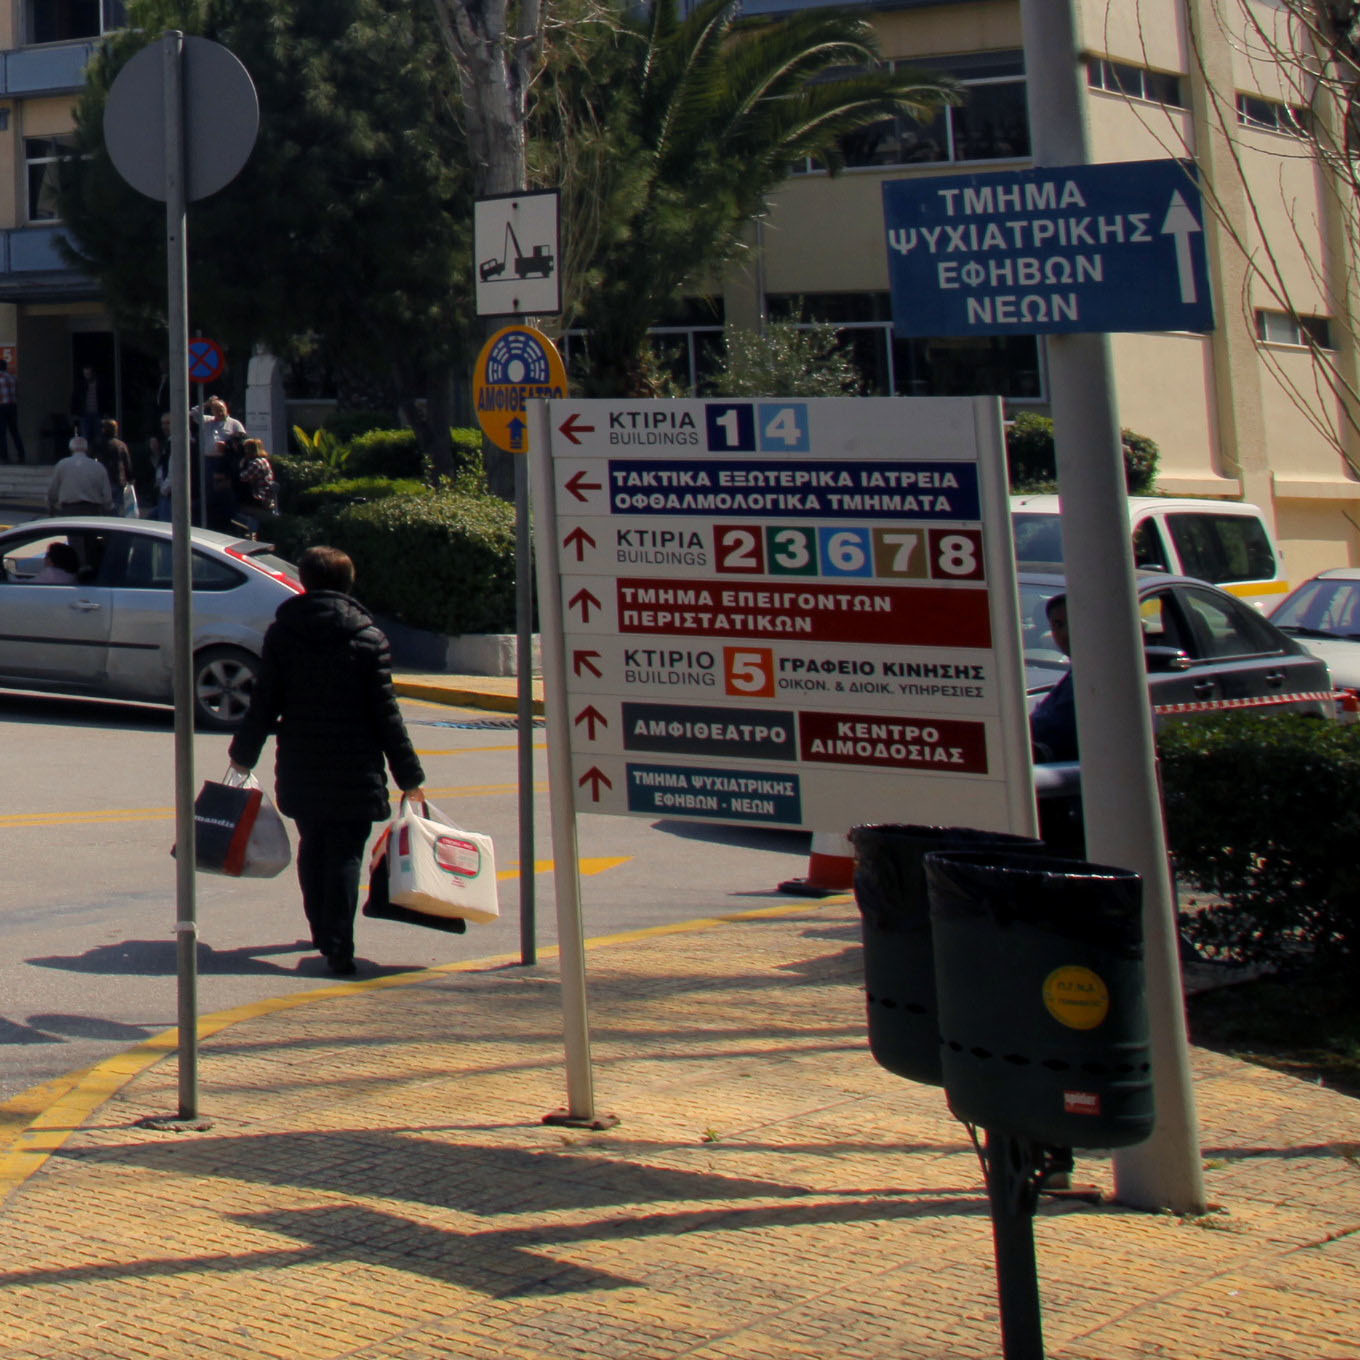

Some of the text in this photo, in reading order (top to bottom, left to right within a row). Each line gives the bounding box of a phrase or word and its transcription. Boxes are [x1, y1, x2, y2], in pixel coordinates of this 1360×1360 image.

[937, 180, 1088, 217] ΤΜΗΜΑ
[888, 213, 1153, 255] ΨΥΧΙΑΤΡΙΚΗΣ
[937, 254, 1105, 289] ΕΦΗΒΩΝ
[967, 293, 1079, 324] ΝΕΩΝ
[2, 349, 12, 362] 5
[609, 408, 802, 446] ΚΤΙΡΙΑ 1 4
[609, 431, 699, 445] BUILDINGS
[612, 470, 959, 489] ΤΑΚΤΙΚΑ ΕΞΩΤΕΡΙΚΑ ΙΑΤΡΕΙΑ
[614, 493, 952, 512] ΟΦΘΑΛΜΟΛΟΓΙΚΑ ΤΜΗΜΑΤΑ
[616, 529, 977, 575] ΚΤΙΡΙΑ 2 3 6 7 8
[616, 549, 707, 566] BUILDINGS
[621, 588, 892, 612] ΤΜΗΜΑ ΕΠΕΙΓΟΝΤΩΝ
[623, 610, 812, 633] ΠΕΡΙΣΤΑΤΙΚΩΝ
[624, 649, 767, 692] ΚΤΙΡΙΟ 5
[625, 670, 716, 687] BUILDING
[779, 658, 986, 681] ΓΡΑΦΕΙΟ ΚΙΝΗΣΗΣ
[778, 678, 985, 698] ΟΙΚΟΝ. & ΔΙΟΙΚ. ΥΠΗΡΕΣΙΕΣ
[634, 719, 787, 743] ΑΜΦΙΘΕΑΤΡΟ
[837, 721, 940, 743] ΚΕΝΤΡΟ
[810, 738, 965, 764] ΑΙΜΟΔΟΣΙΑΣ
[632, 771, 795, 796] ΤΜΗΜΑ ΨΥΧΙΑΤΡΙΚΗΣ
[654, 791, 718, 810] ΕΦΗΒΩΝ
[731, 798, 775, 815] ΝΕΩΝ
